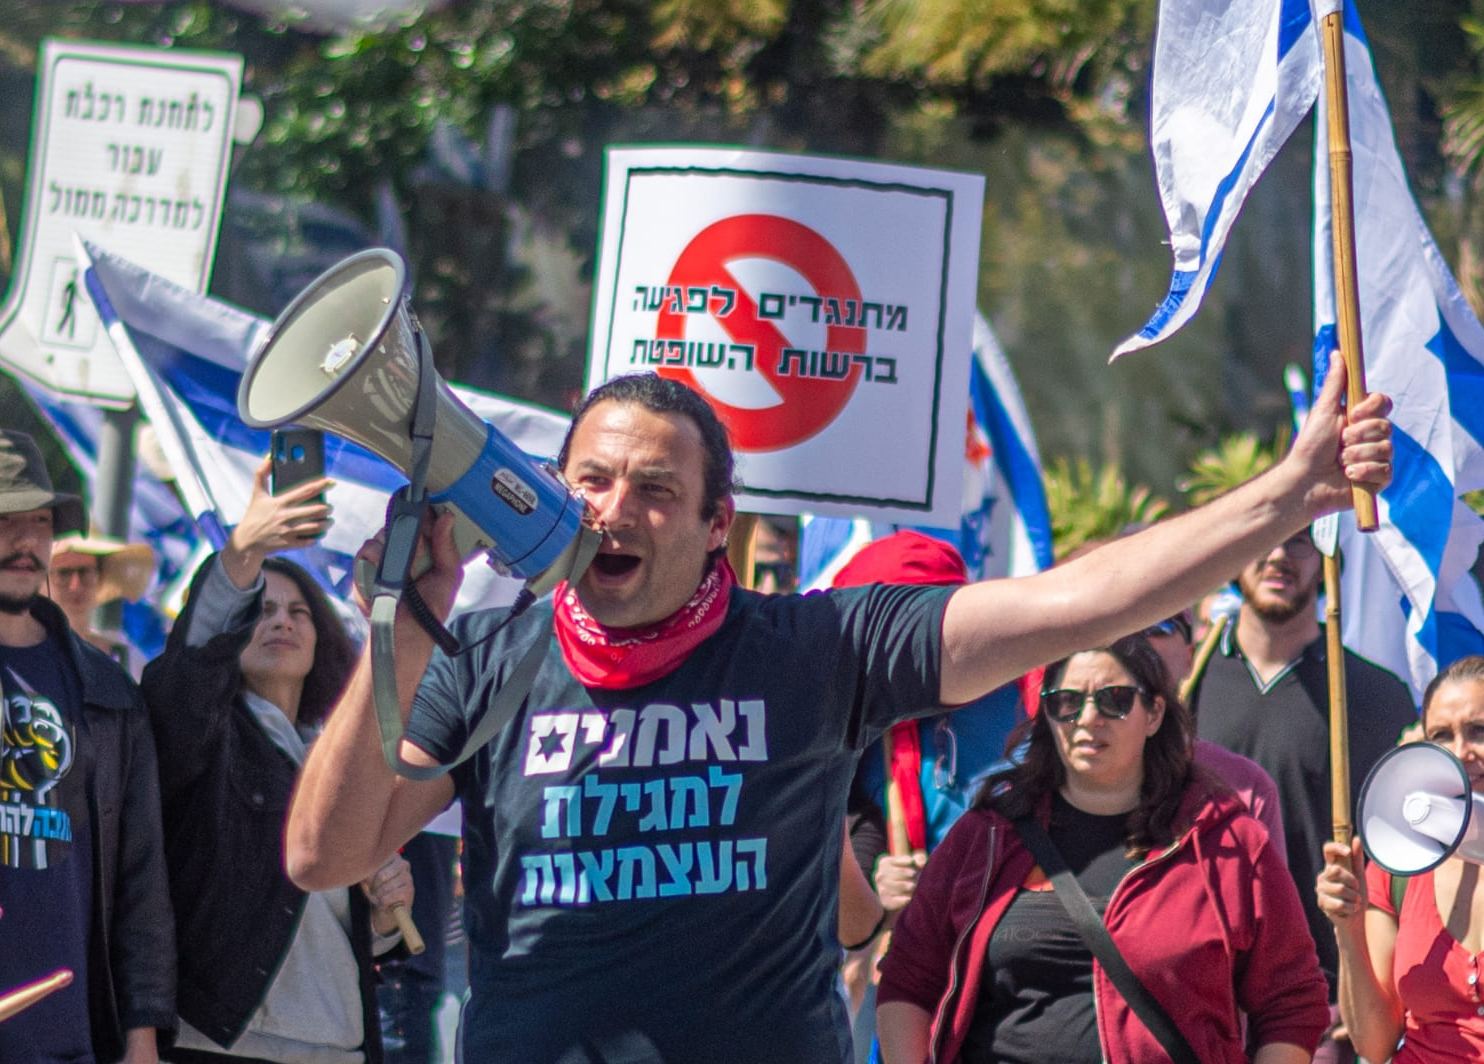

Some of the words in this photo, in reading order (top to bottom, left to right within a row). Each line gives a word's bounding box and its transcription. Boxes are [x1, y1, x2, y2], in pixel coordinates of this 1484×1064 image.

[66, 88, 125, 122] רכבת
[138, 97, 214, 132] לתחנת
[107, 142, 163, 175] עבור
[49, 181, 106, 218] ממול
[115, 193, 204, 230] למדרכה
[633, 285, 737, 316] לפגיעה
[758, 292, 908, 331] מתנגדים
[630, 339, 755, 371] השופטת
[778, 347, 898, 384] ברשות
[494, 483, 528, 514] MEGAPHONE
[524, 699, 768, 776] נאמנים
[541, 766, 743, 838] למגילת
[521, 838, 768, 906] העצמאות
